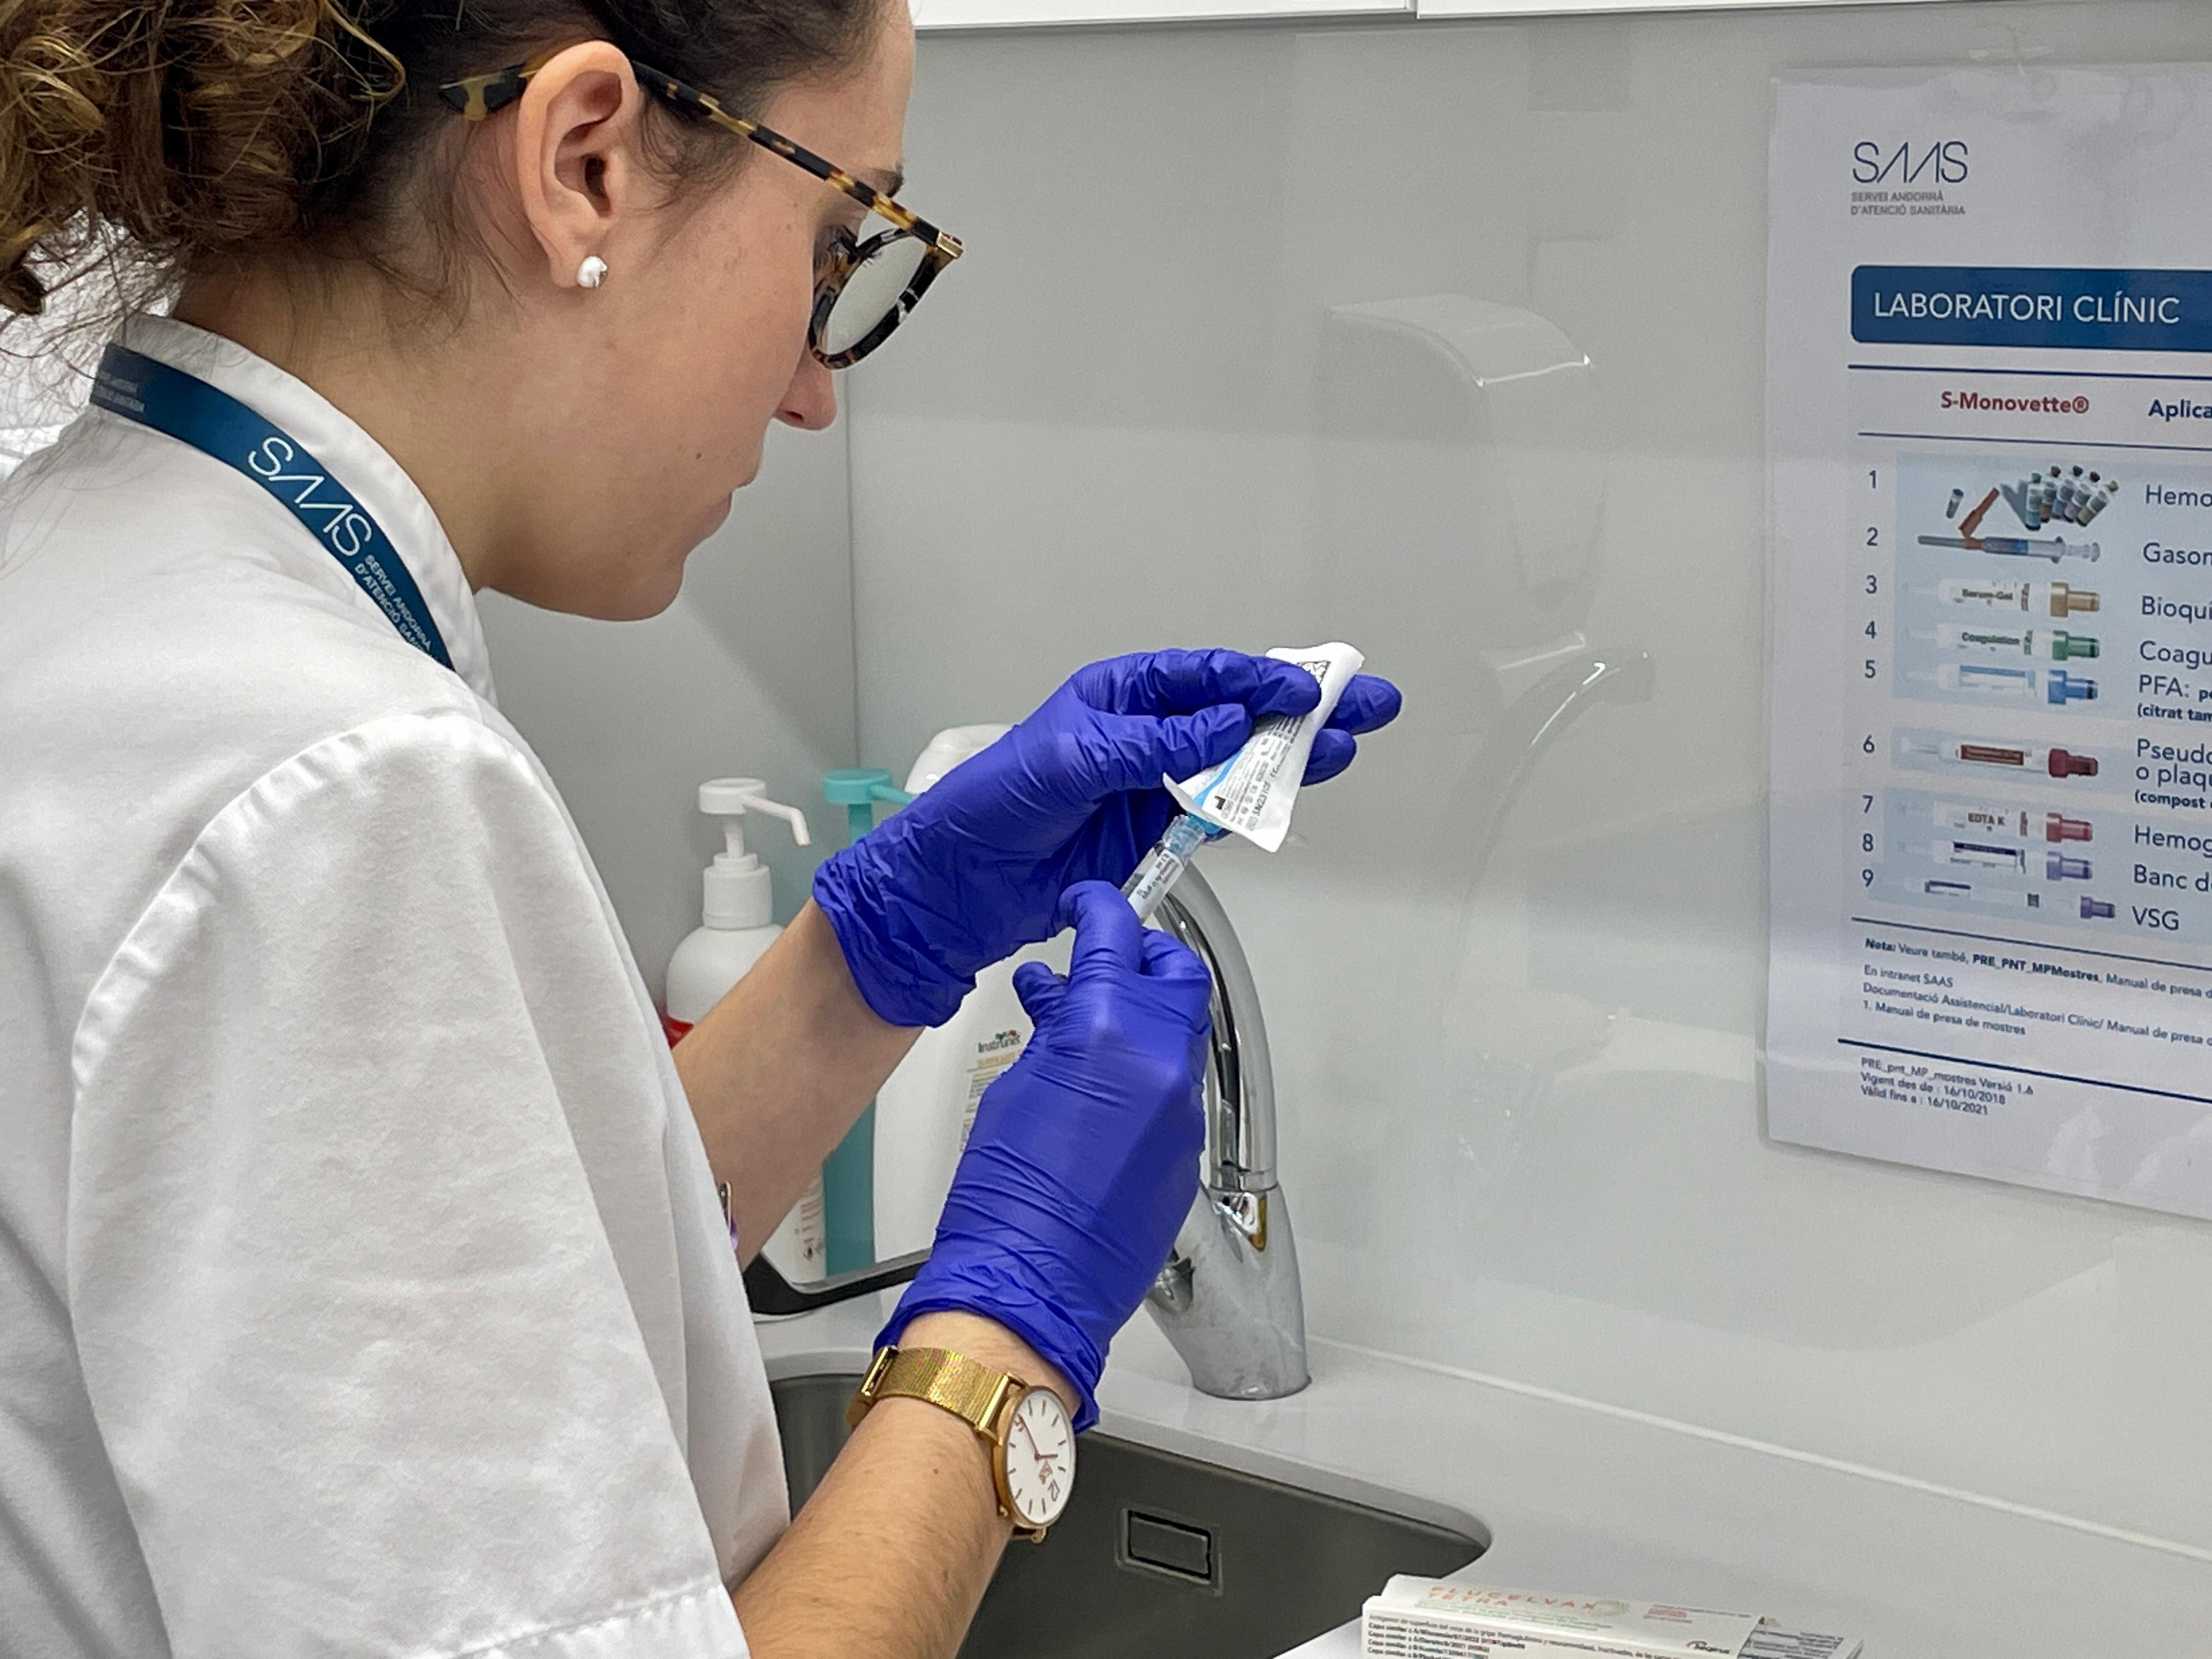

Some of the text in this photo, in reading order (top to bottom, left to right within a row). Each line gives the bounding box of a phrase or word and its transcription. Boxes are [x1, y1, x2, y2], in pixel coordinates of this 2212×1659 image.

[1852, 141, 1968, 183] SAAS
[1851, 191, 1888, 202] SERVEI
[1874, 289, 2180, 325] LABORATORI CLÍNIC
[1869, 470, 1877, 488] 1
[248, 437, 373, 556] SAAS
[2146, 484, 2212, 507] Hemo
[1866, 527, 1878, 546] 2
[365, 555, 396, 596] SERVEI
[1865, 575, 1877, 594] 3
[1865, 620, 1877, 639] 4
[1865, 659, 1876, 678] 5
[2140, 674, 2190, 697] PFA:
[2137, 703, 2182, 720] (citrat
[1863, 735, 1875, 754] 6
[2136, 763, 2212, 792] o plaq
[1863, 794, 1874, 814] 7
[2135, 789, 2205, 809] (compost
[1862, 833, 1874, 852] 8
[1861, 869, 1874, 888] 9
[2134, 864, 2187, 889] Banc
[2132, 906, 2179, 930] VSG
[1865, 965, 1877, 976] En
[1923, 973, 1953, 988] SAAS
[2107, 973, 2148, 989] Manual
[2152, 981, 2166, 991] de
[2170, 985, 2202, 997] presa
[1875, 1002, 1914, 1017] Manual
[1917, 1008, 1930, 1019] de
[1966, 1017, 1979, 1027] de
[1983, 1020, 2025, 1035] mostres
[2107, 1020, 2149, 1036] Manual
[2153, 1027, 2168, 1039] de
[2171, 1031, 2203, 1044] presa
